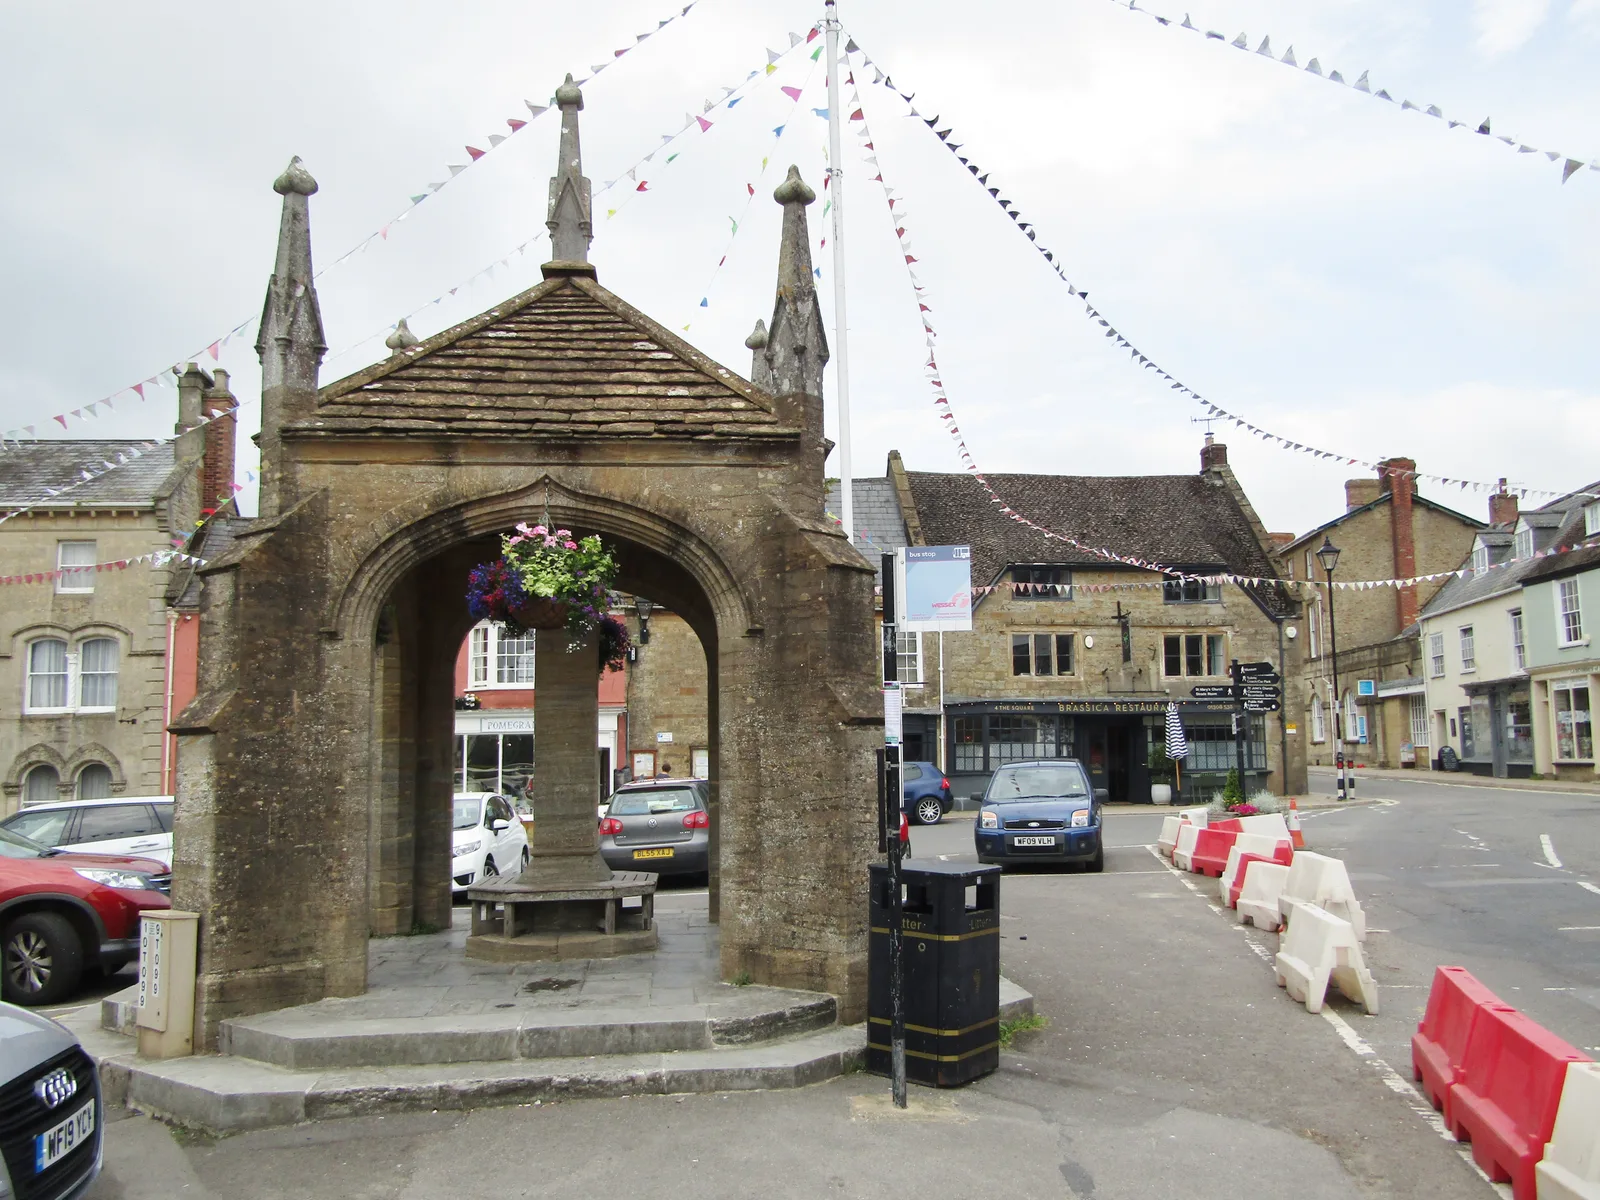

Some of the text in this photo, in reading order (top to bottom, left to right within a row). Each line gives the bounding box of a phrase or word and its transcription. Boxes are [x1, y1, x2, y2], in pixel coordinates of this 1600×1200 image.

[1058, 703, 1180, 712] BRASSICA RESTAURAT
[902, 918, 921, 930] tter
[48, 1120, 74, 1160] WF19
